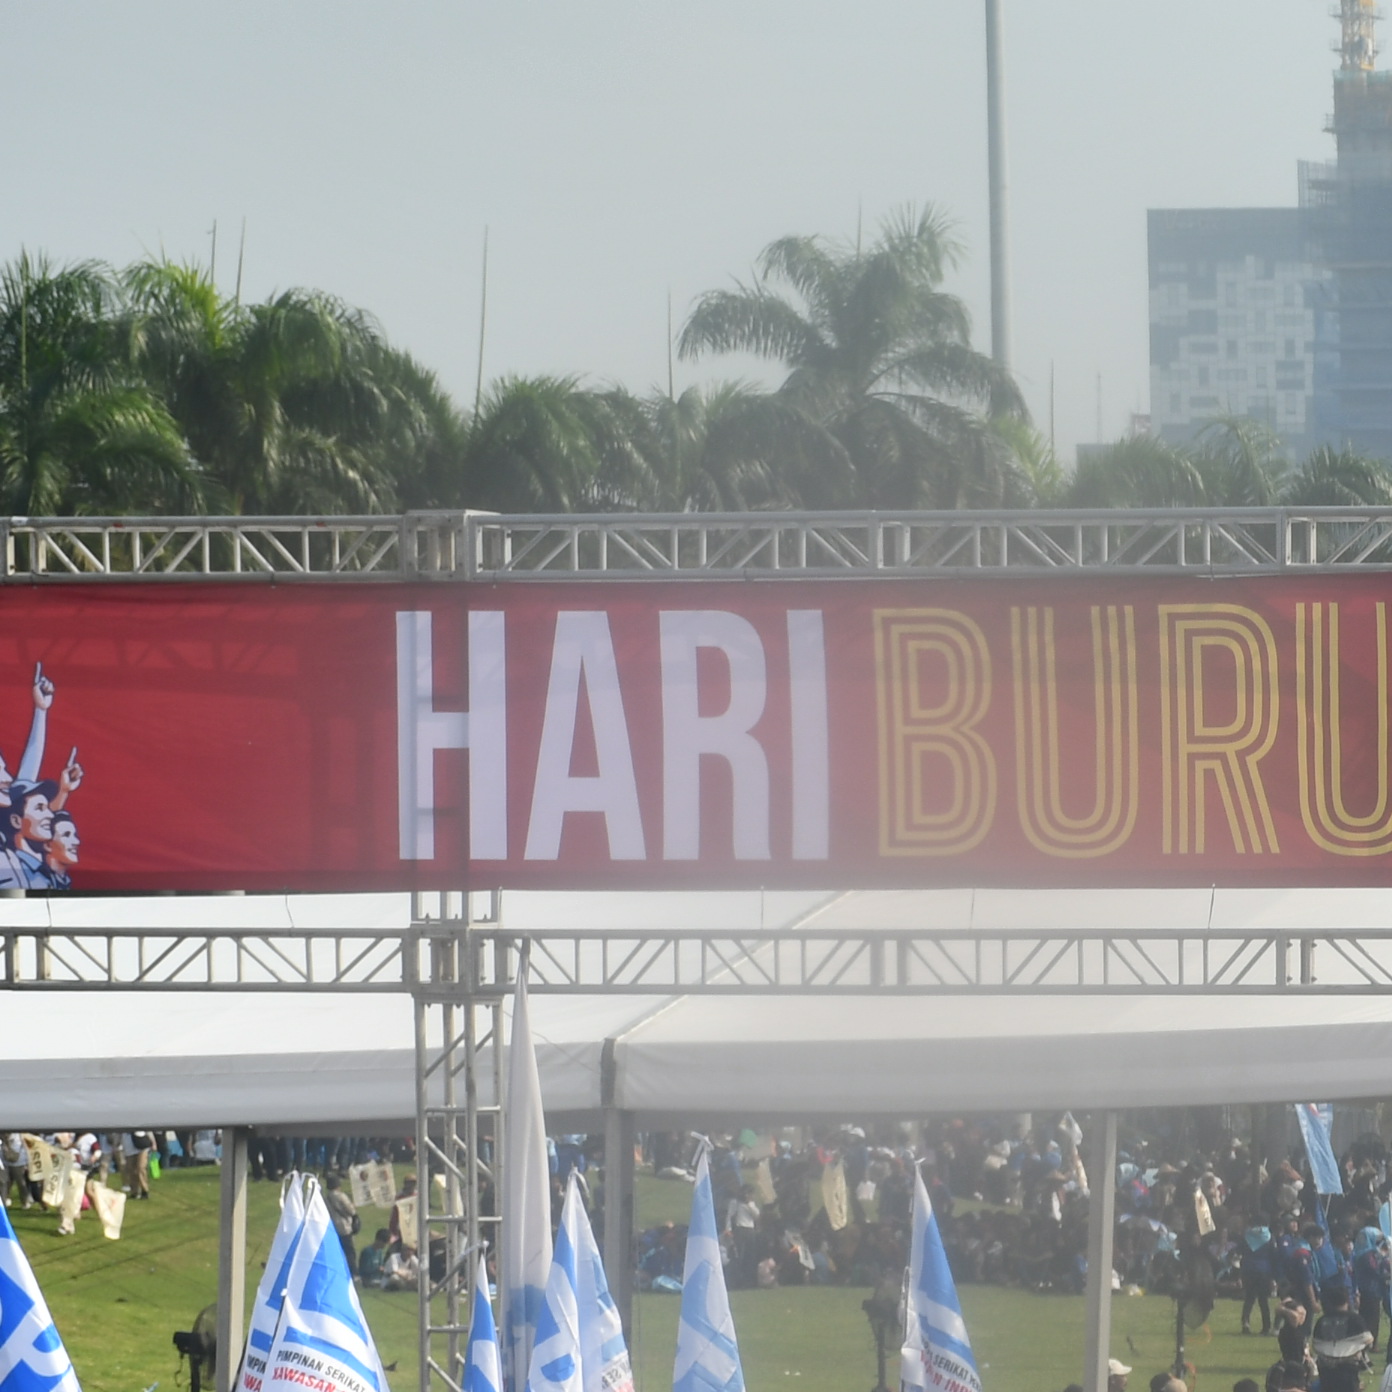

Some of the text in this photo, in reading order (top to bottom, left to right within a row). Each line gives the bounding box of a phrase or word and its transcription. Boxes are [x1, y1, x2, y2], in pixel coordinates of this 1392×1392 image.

[395, 608, 830, 862] HARI
[277, 1349, 324, 1373] PIMPINAN
[932, 1353, 970, 1381] SERIKAT
